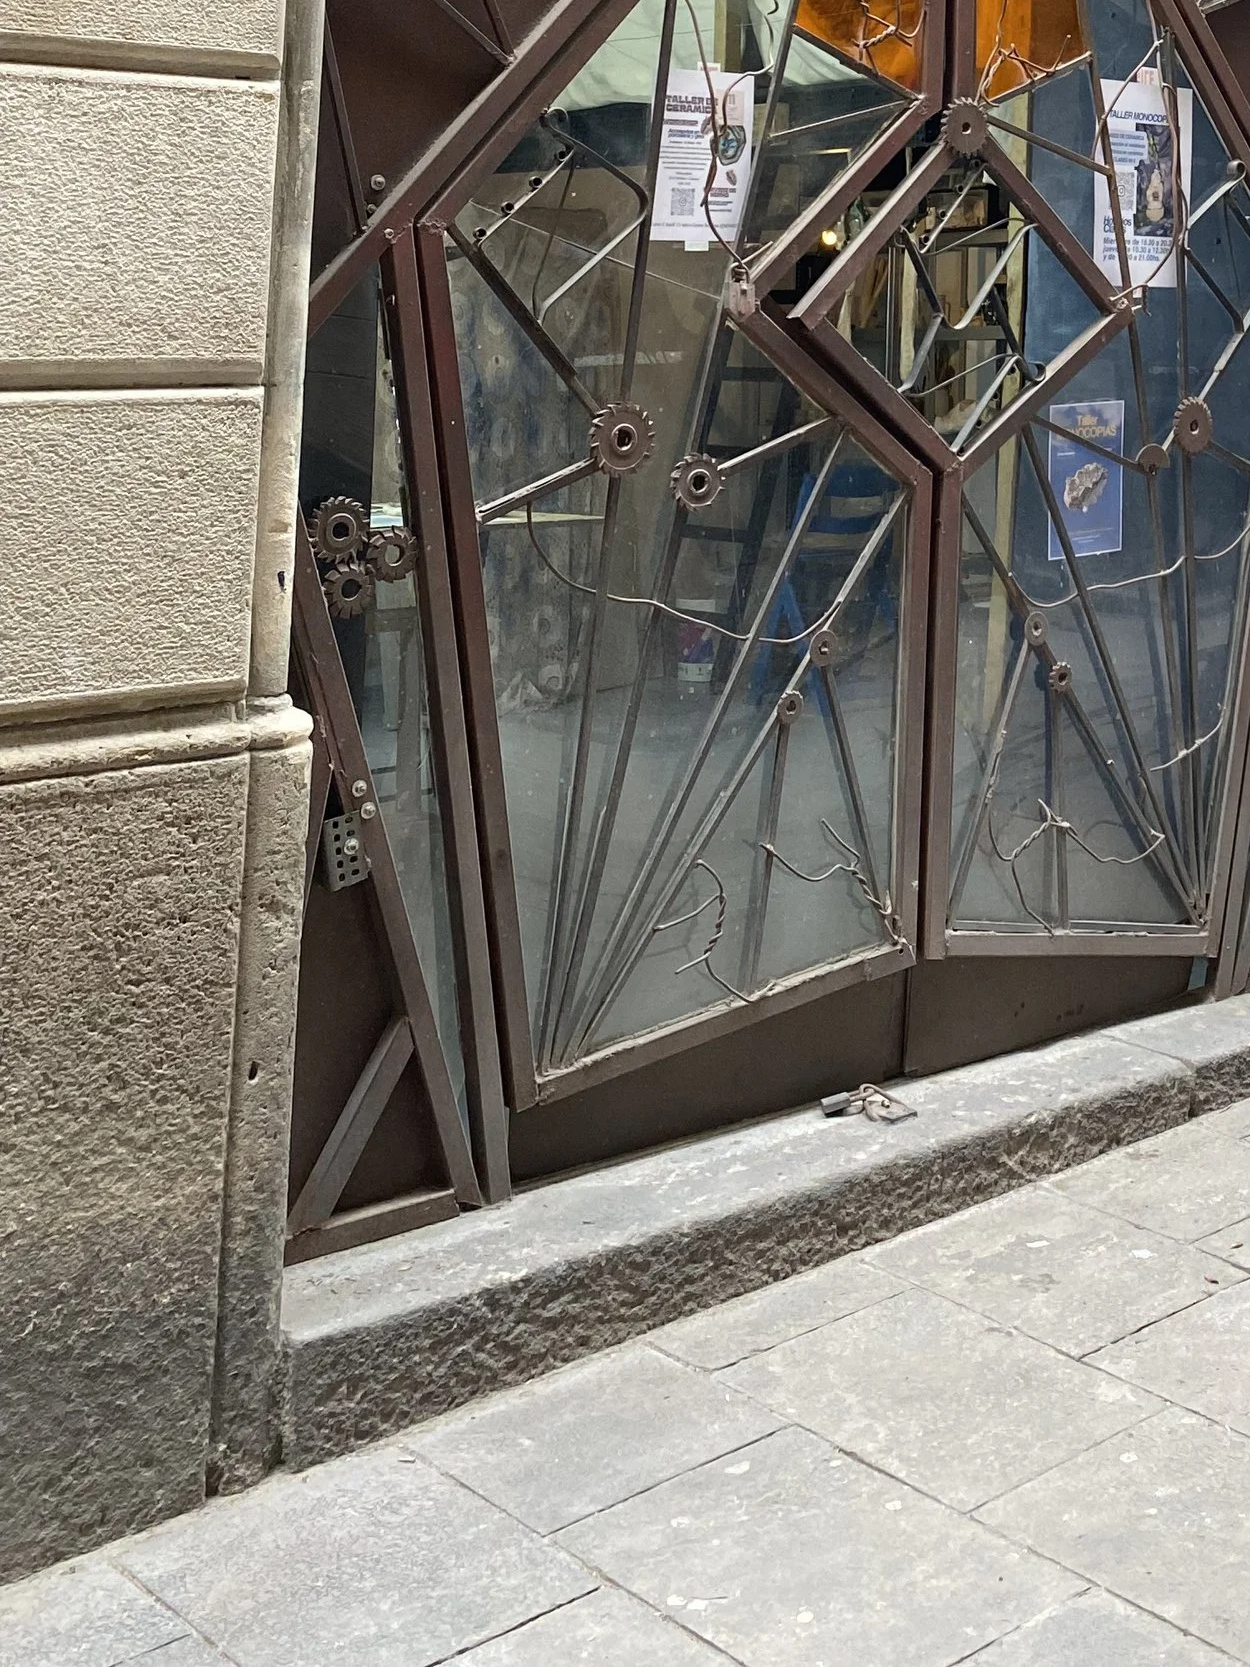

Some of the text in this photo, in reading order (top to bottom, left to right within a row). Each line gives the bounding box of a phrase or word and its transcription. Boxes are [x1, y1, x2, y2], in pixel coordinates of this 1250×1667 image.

[665, 94, 705, 104] TALLER
[665, 103, 718, 114] CERAMIC
[1109, 110, 1170, 122] TALLER MONOCOP
